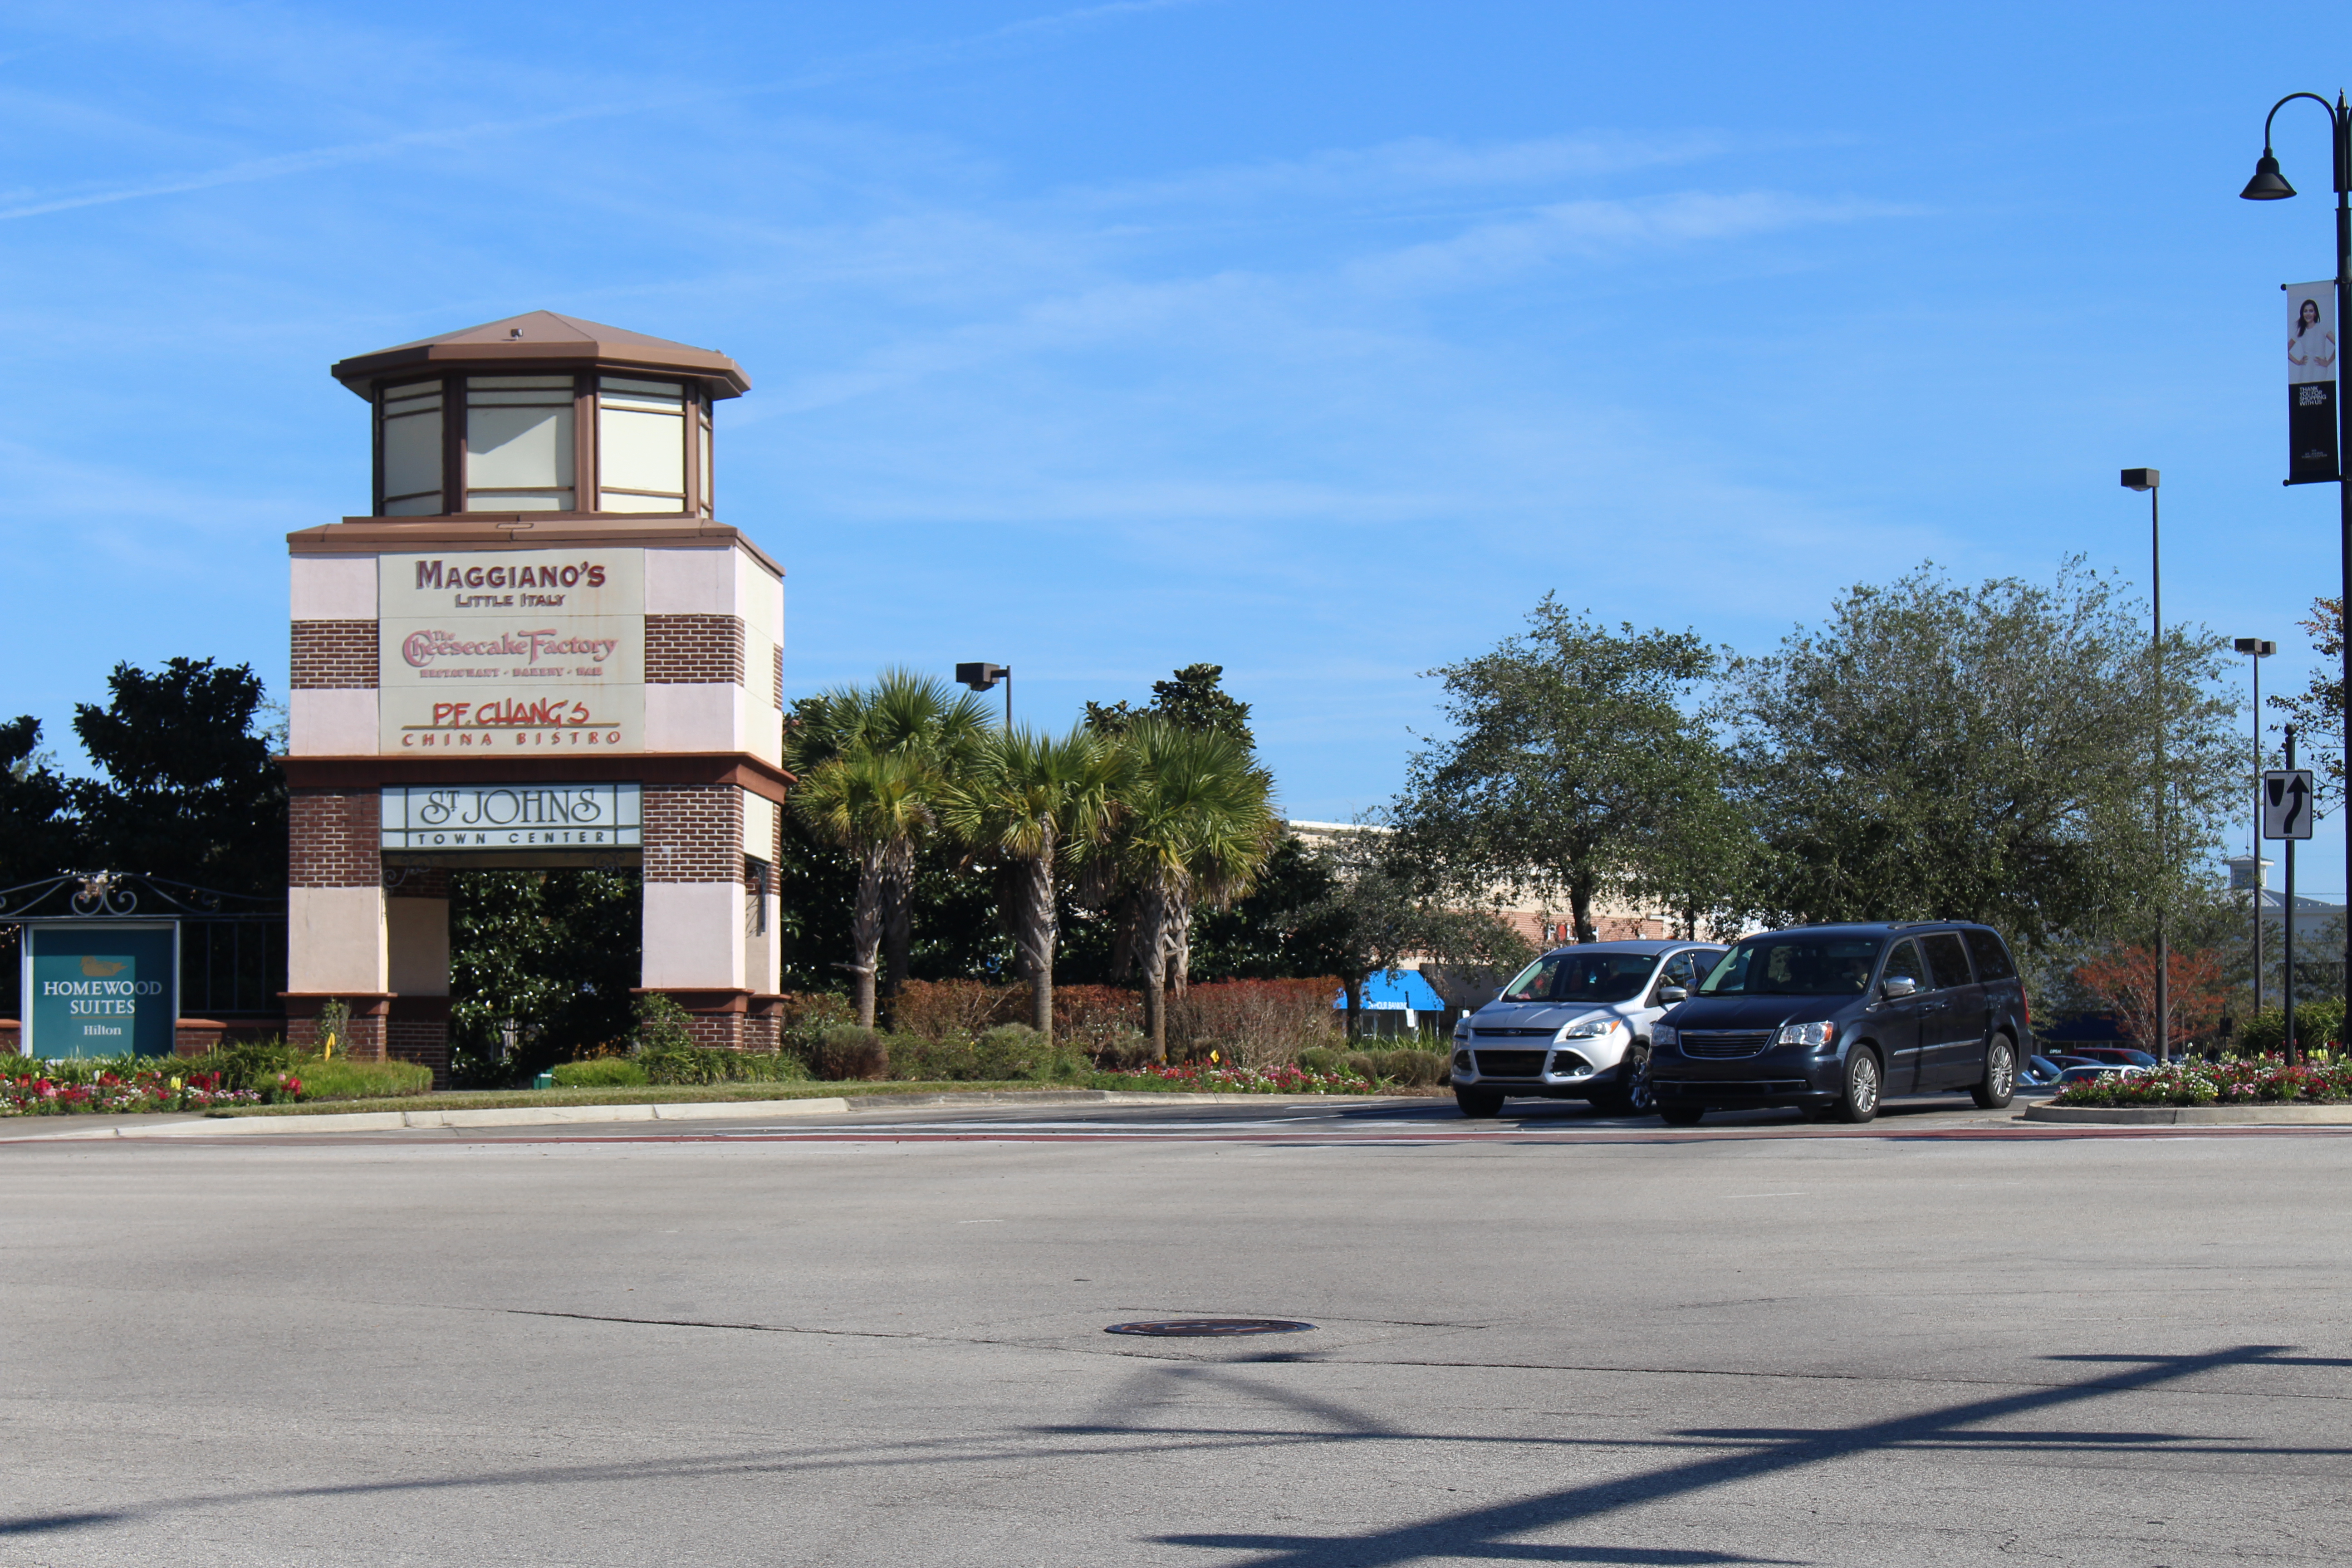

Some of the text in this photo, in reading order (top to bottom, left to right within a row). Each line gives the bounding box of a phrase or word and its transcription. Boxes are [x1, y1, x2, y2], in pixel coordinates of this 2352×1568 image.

[415, 560, 606, 589] MAGGIANO'S
[455, 593, 566, 608] LITTLE ITALY
[402, 628, 619, 667] Cheesecake Factory
[420, 666, 603, 678] RESTAURANT BAKERY BAR
[402, 731, 621, 746] CHINA BISTRO
[462, 788, 602, 824] JOHNS
[418, 832, 604, 845] TOWN CENTER
[44, 981, 162, 995] HOMEWOOD
[70, 1000, 135, 1014] SUITES
[83, 1024, 122, 1035] Hilton
